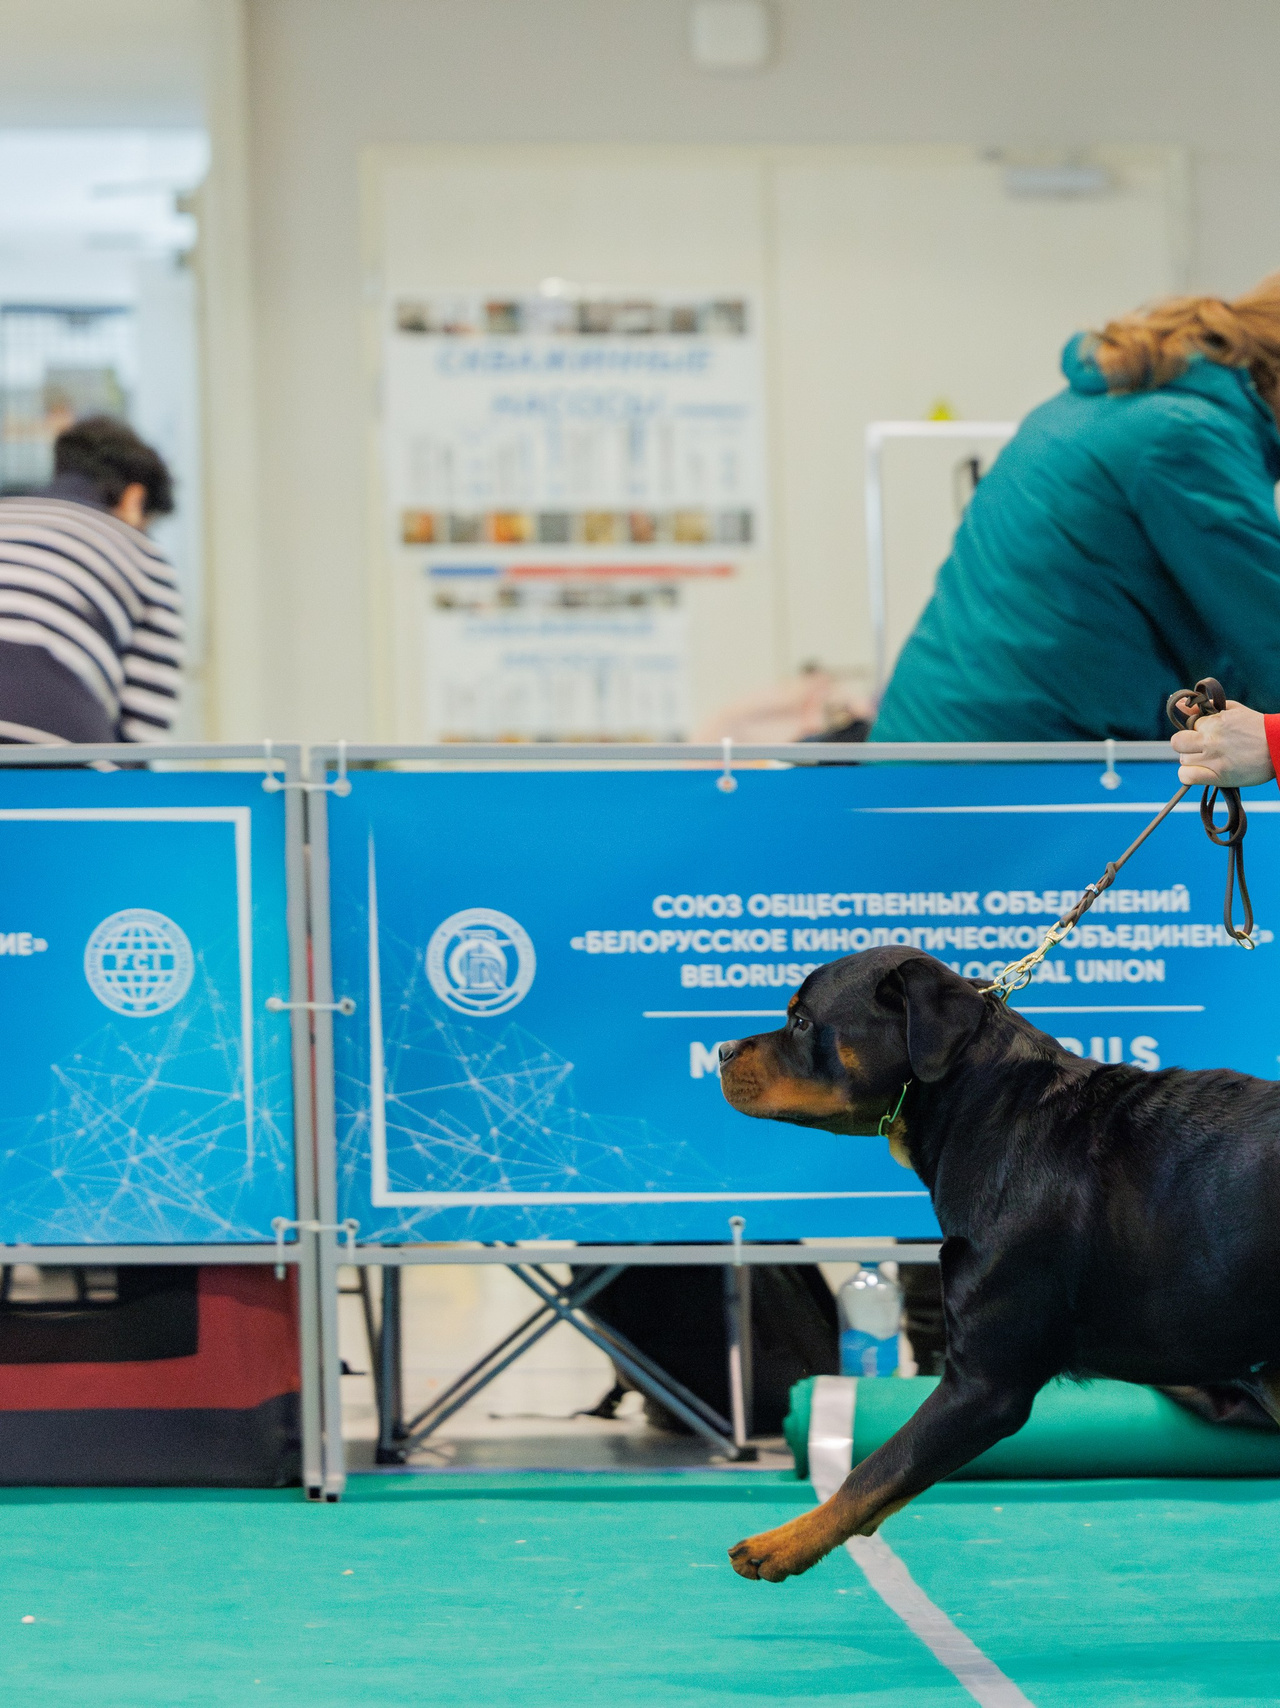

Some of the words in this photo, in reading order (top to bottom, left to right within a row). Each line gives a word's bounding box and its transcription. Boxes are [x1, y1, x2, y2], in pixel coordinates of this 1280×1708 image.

[652, 893, 744, 919] СОЮЗ
[747, 891, 981, 920] ОБЩЕСТВЕННЫХ
[569, 928, 788, 954] «БЕЛОРУССКОЕ
[680, 962, 825, 988] BELORUS
[1075, 958, 1166, 984] UNION
